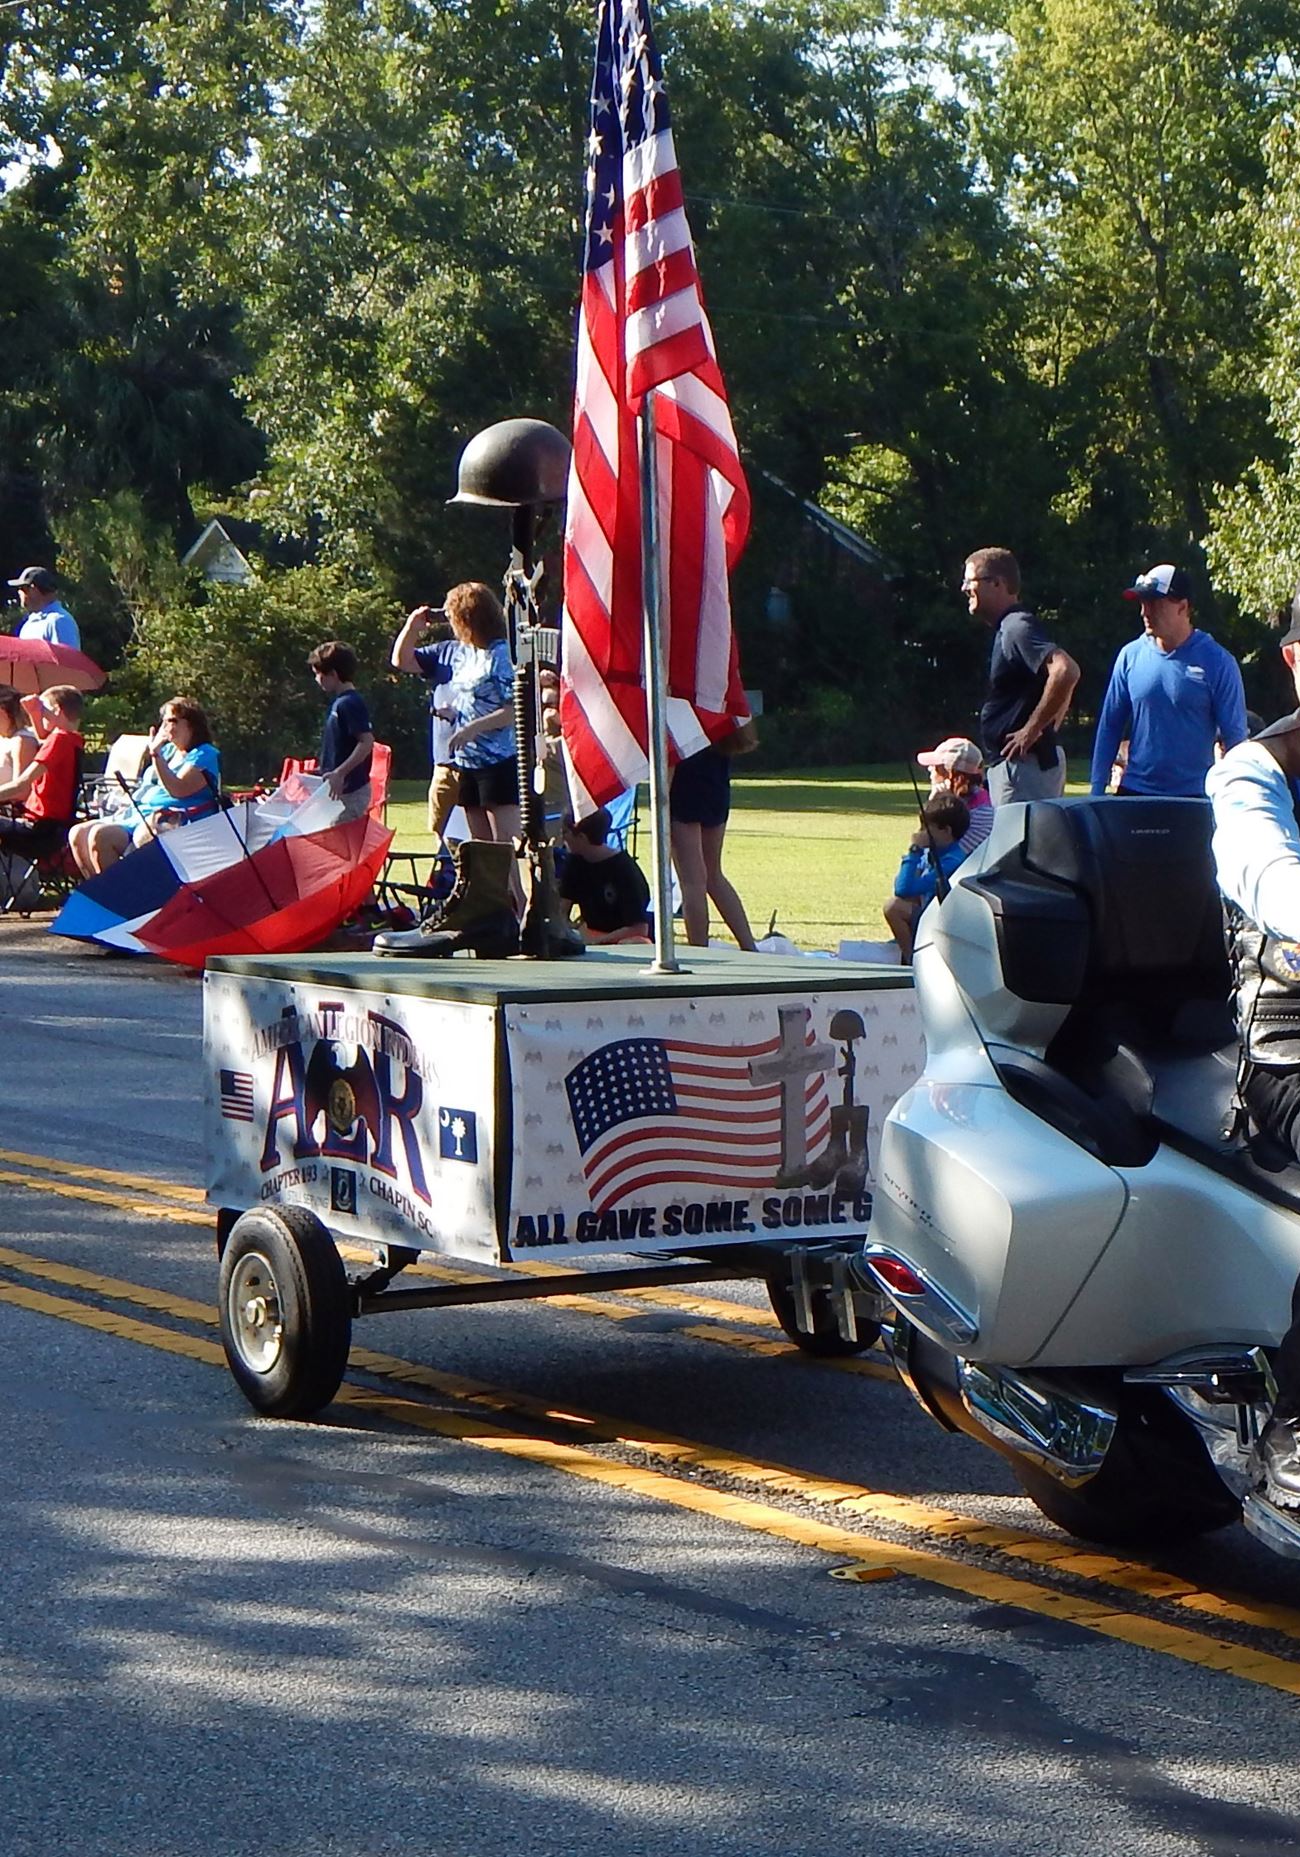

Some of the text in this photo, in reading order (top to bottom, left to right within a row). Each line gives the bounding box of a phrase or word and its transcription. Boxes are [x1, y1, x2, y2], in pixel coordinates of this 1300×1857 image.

[261, 1164, 318, 1201] CHAPTER 193
[369, 1176, 416, 1223] CHAPIN
[417, 1210, 434, 1239] SC
[516, 1213, 569, 1247] ALL
[576, 1207, 657, 1243] GAVE
[662, 1201, 756, 1237] SOME,
[762, 1194, 846, 1229] SOME
